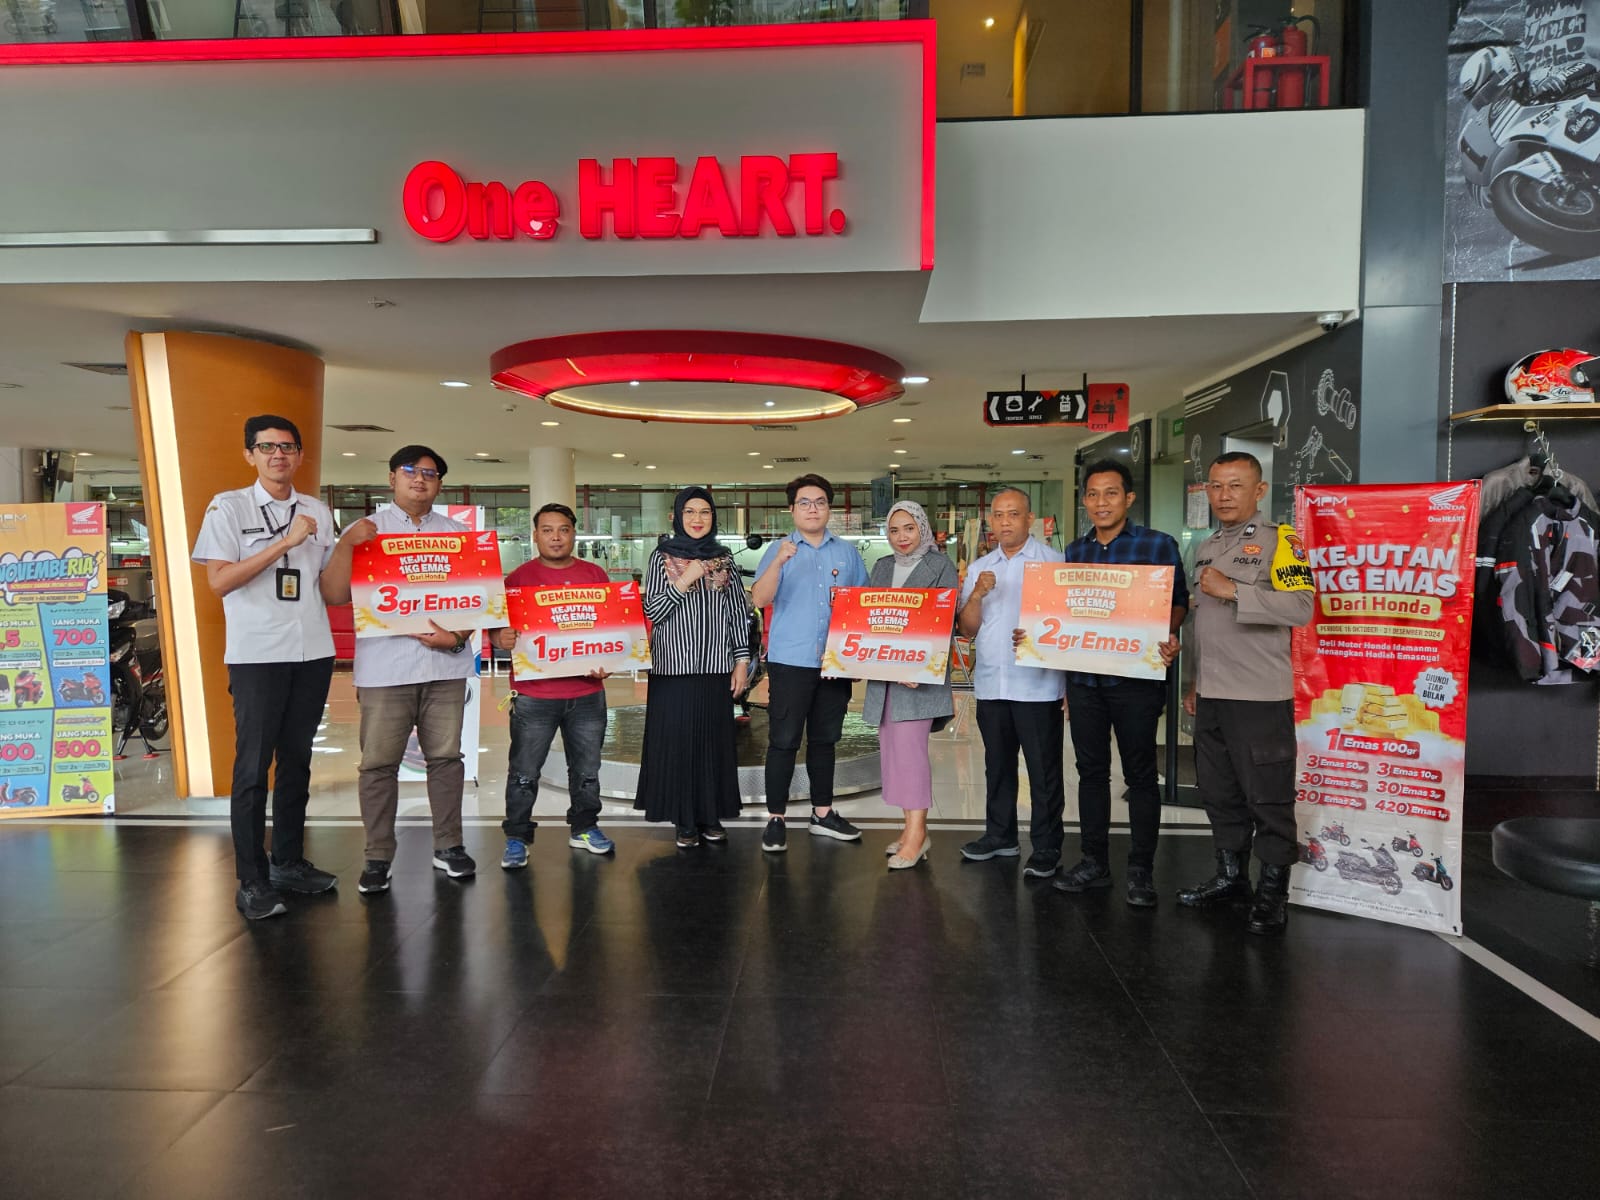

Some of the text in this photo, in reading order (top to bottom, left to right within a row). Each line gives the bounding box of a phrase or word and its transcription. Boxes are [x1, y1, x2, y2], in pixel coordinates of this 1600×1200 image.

[1530, 104, 1560, 128] NSR
[403, 152, 847, 243] One HEART.
[1306, 495, 1347, 507] MPM
[388, 539, 457, 551] PEMENANG
[400, 554, 449, 565] KEJUTAN
[1233, 557, 1262, 566] POLRI
[1309, 543, 1458, 570] KEJUTAN
[399, 563, 452, 575] 1KG EMAS
[425, 573, 445, 581] Honda
[1059, 570, 1127, 584] PEMENANG
[1366, 567, 1461, 598] EMAS
[540, 590, 602, 603] PEMENANG
[864, 594, 919, 605] PEMENANG
[1067, 588, 1116, 598] KEJUTAN
[376, 585, 482, 616] 3gr Emas
[1065, 598, 1117, 610] 1KG EMAS
[1329, 597, 1431, 615] Dari Honda
[551, 604, 595, 615] KEJUTAN
[869, 608, 909, 618] KEJUTAN
[10, 620, 35, 628] MUKA
[551, 612, 597, 624] 1KG EMAS
[867, 617, 909, 627] 1KG EMAS
[52, 628, 97, 646] 700
[1037, 617, 1142, 653] 2gr Emas
[1424, 630, 1441, 638] 2024
[532, 635, 624, 662] 1gr Emas
[841, 633, 927, 662] 5gr Emas
[1319, 639, 1438, 652] Beli Motor Honda Idamanmu
[1317, 648, 1441, 663] Menangkan Hadiah Emasnya!
[1425, 673, 1450, 685] DIUNDI
[1428, 682, 1444, 692] TIAP
[1422, 690, 1446, 702] BULAN
[15, 732, 41, 740] MUKA
[81, 729, 106, 737] MUKA
[1325, 727, 1418, 756] 1 Emas 100gr
[54, 739, 101, 758] 500
[1306, 754, 1319, 768] 3
[1320, 759, 1345, 768] Emas
[1375, 762, 1439, 780] 3 Emas 10gr
[1299, 771, 1323, 785] 30
[1324, 777, 1349, 787] Emas
[1375, 780, 1400, 794] 30
[1402, 786, 1429, 796] Emas
[1296, 789, 1320, 802] 30
[1324, 795, 1348, 805] Emas
[1374, 799, 1409, 815] 420
[1411, 805, 1437, 816] Emas
